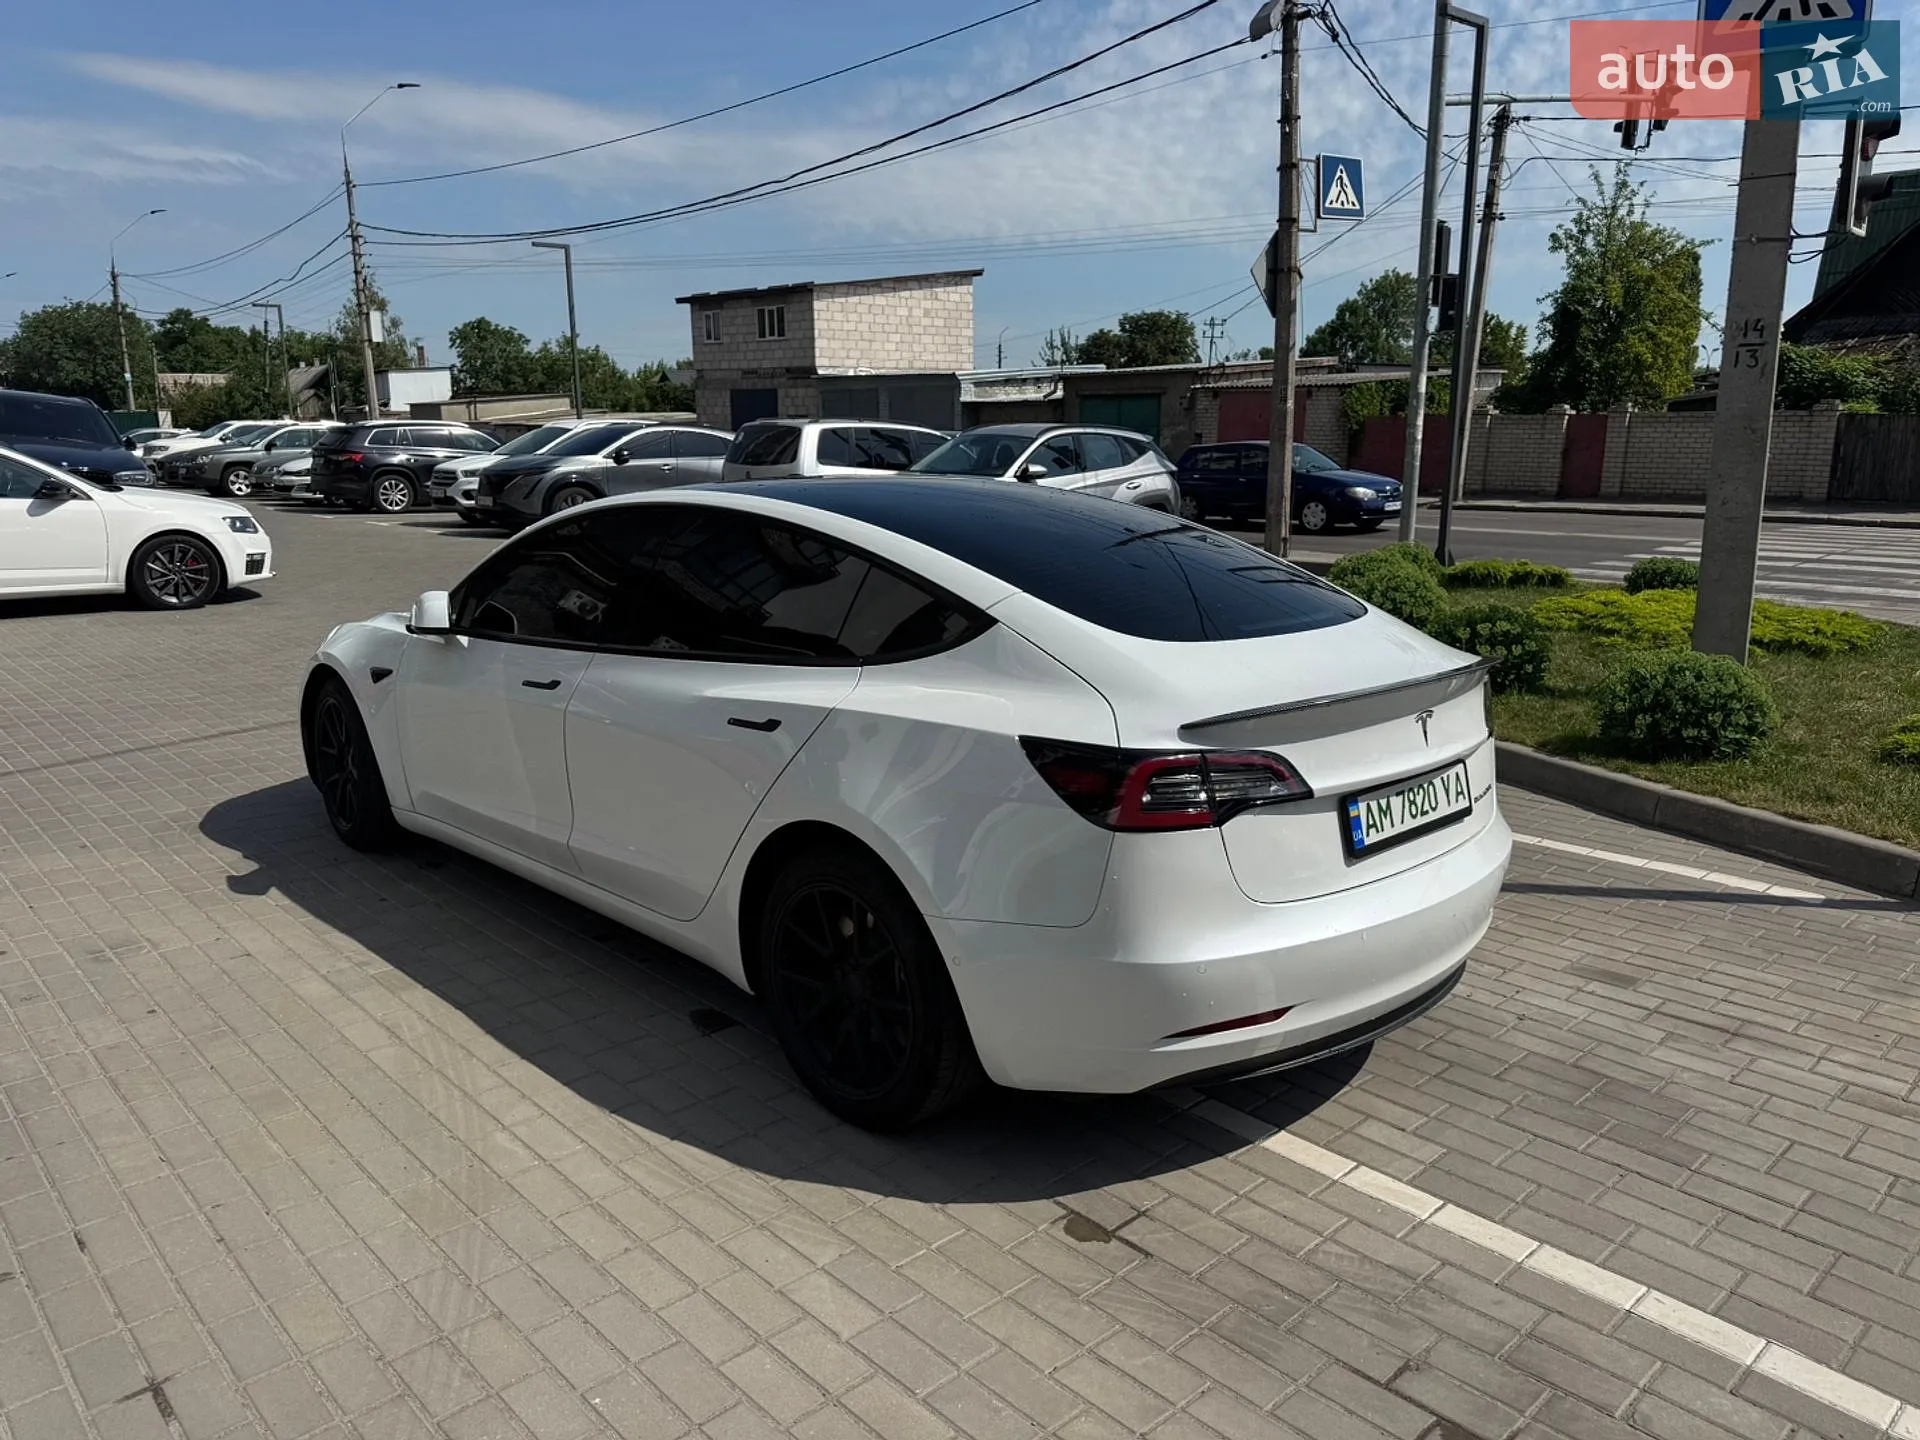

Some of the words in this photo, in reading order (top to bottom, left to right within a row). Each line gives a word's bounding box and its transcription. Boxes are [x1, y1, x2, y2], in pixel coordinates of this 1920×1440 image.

[1742, 318, 1765, 339] 14
[1733, 349, 1760, 369] 13
[1366, 796, 1395, 837] AM
[1395, 781, 1438, 824] 7820
[1441, 772, 1466, 806] YA
[1353, 829, 1364, 841] UA
